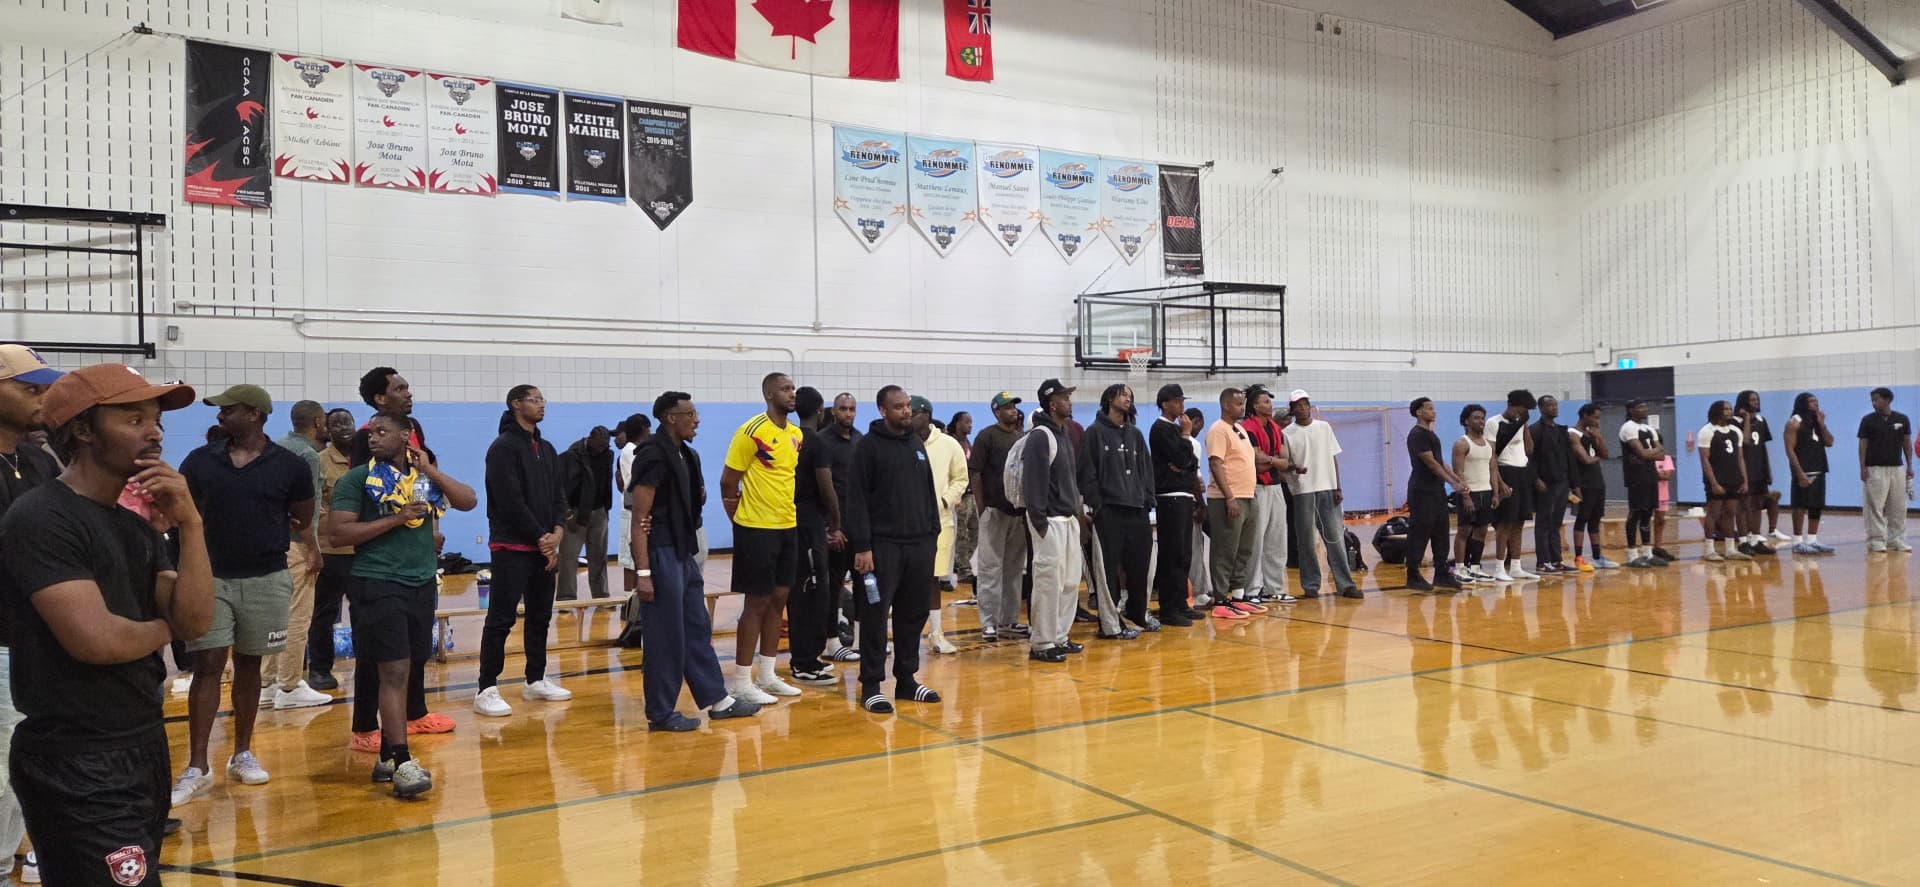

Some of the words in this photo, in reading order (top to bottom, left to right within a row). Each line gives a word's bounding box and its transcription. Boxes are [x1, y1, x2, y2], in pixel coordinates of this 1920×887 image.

[510, 99, 544, 112] JOSE
[504, 110, 551, 126] BRUNO
[630, 106, 663, 116] BASKET-BALL
[664, 109, 687, 119] MASCULIN
[574, 112, 615, 128] KEITH
[507, 122, 548, 137] MOTA
[569, 124, 620, 140] MARIER
[366, 141, 385, 150] Jose
[386, 142, 414, 152] Bruno
[646, 136, 674, 146] 2015-2016
[378, 152, 402, 160] Mota
[440, 148, 457, 157] Jose
[458, 150, 484, 159] Bruno
[451, 158, 474, 167] Mota
[1752, 431, 1759, 445] 9
[1725, 439, 1734, 453] 3
